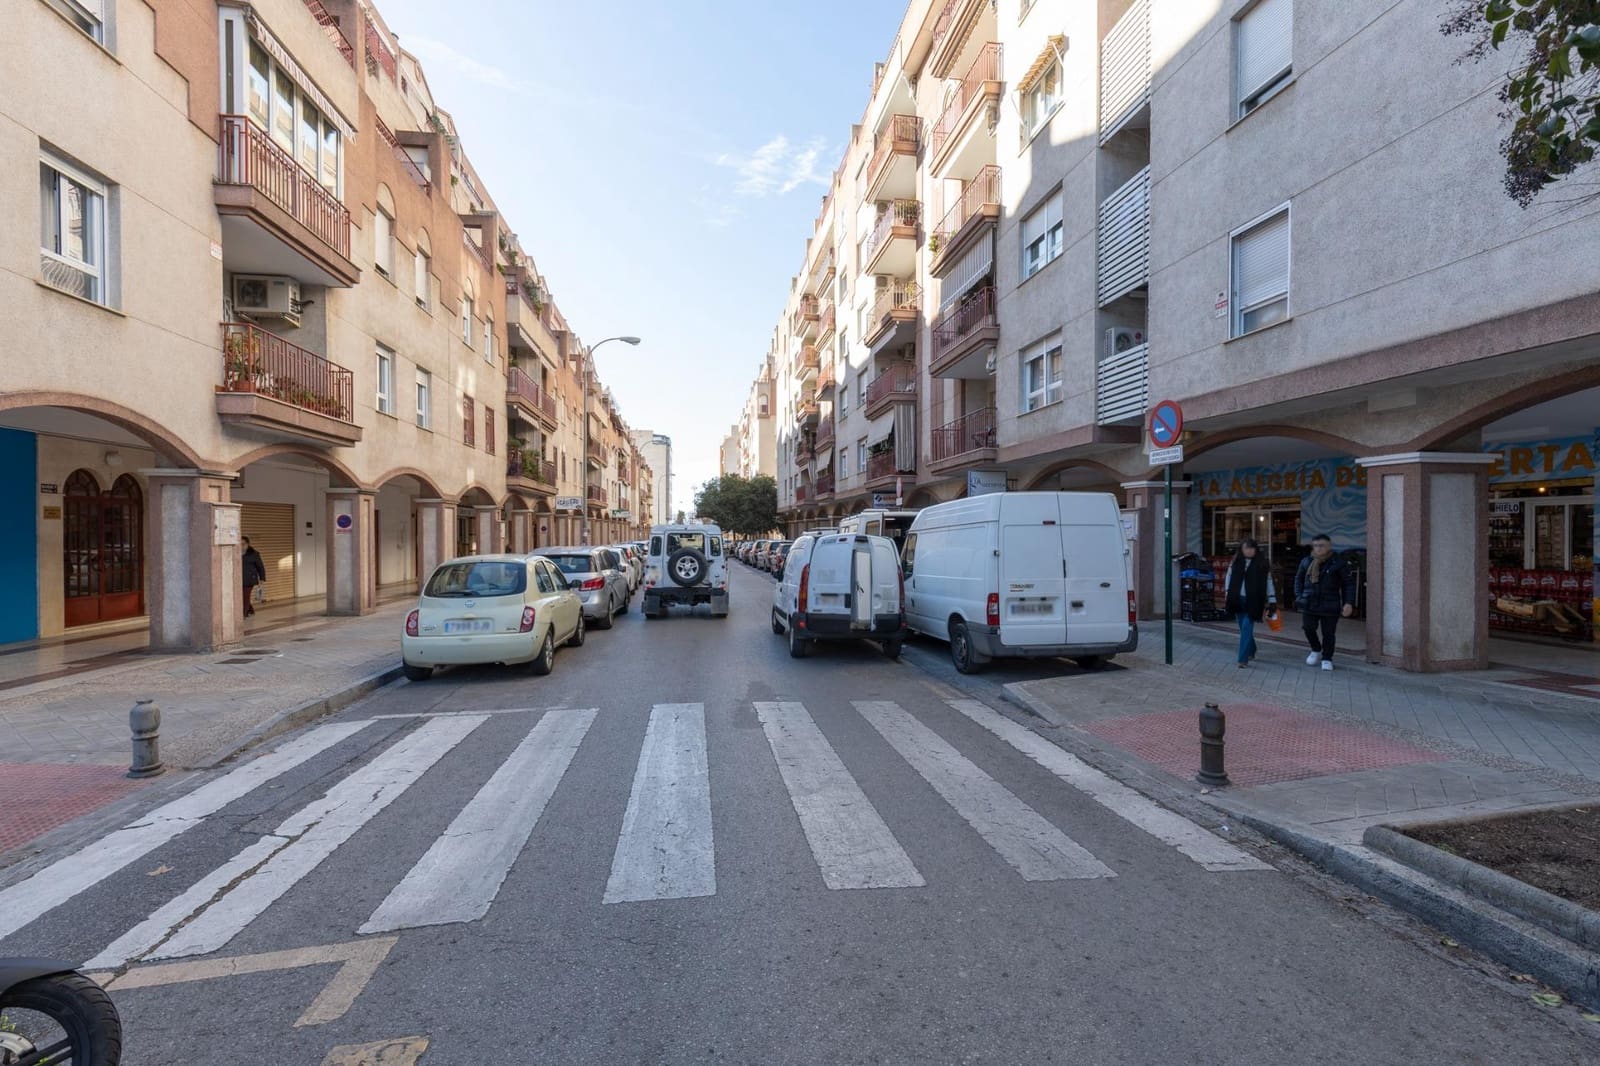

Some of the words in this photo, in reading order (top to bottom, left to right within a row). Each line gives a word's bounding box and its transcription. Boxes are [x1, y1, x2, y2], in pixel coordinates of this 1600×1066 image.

[1199, 478, 1221, 496] LA
[1230, 468, 1326, 495] ALEGRÍA
[1489, 442, 1595, 477] ERTA
[1495, 503, 1519, 512] HIELO
